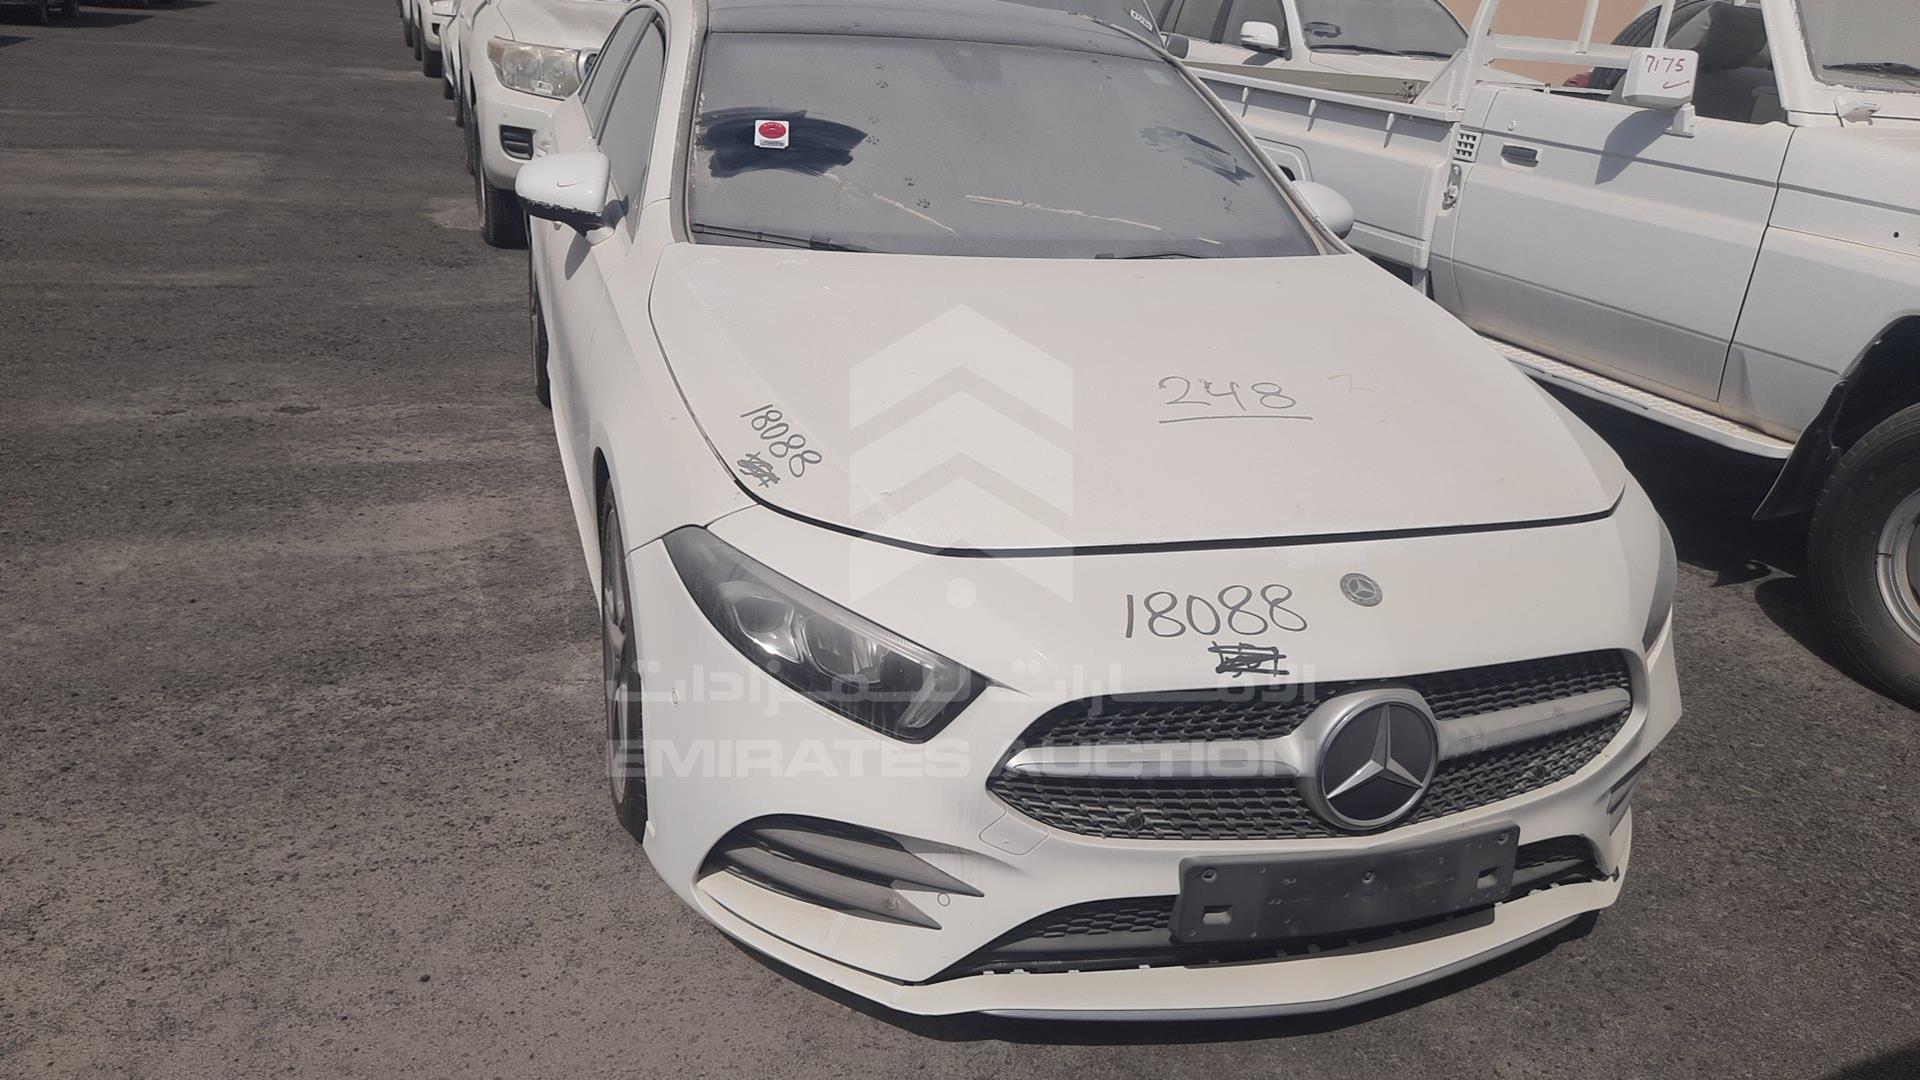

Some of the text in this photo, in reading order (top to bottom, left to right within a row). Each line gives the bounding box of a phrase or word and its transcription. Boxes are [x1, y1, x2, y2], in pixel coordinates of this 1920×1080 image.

[1646, 55, 1685, 72] 7175
[1158, 376, 1297, 411] 248
[740, 404, 822, 478] 18088
[1125, 584, 1308, 639] 18088
